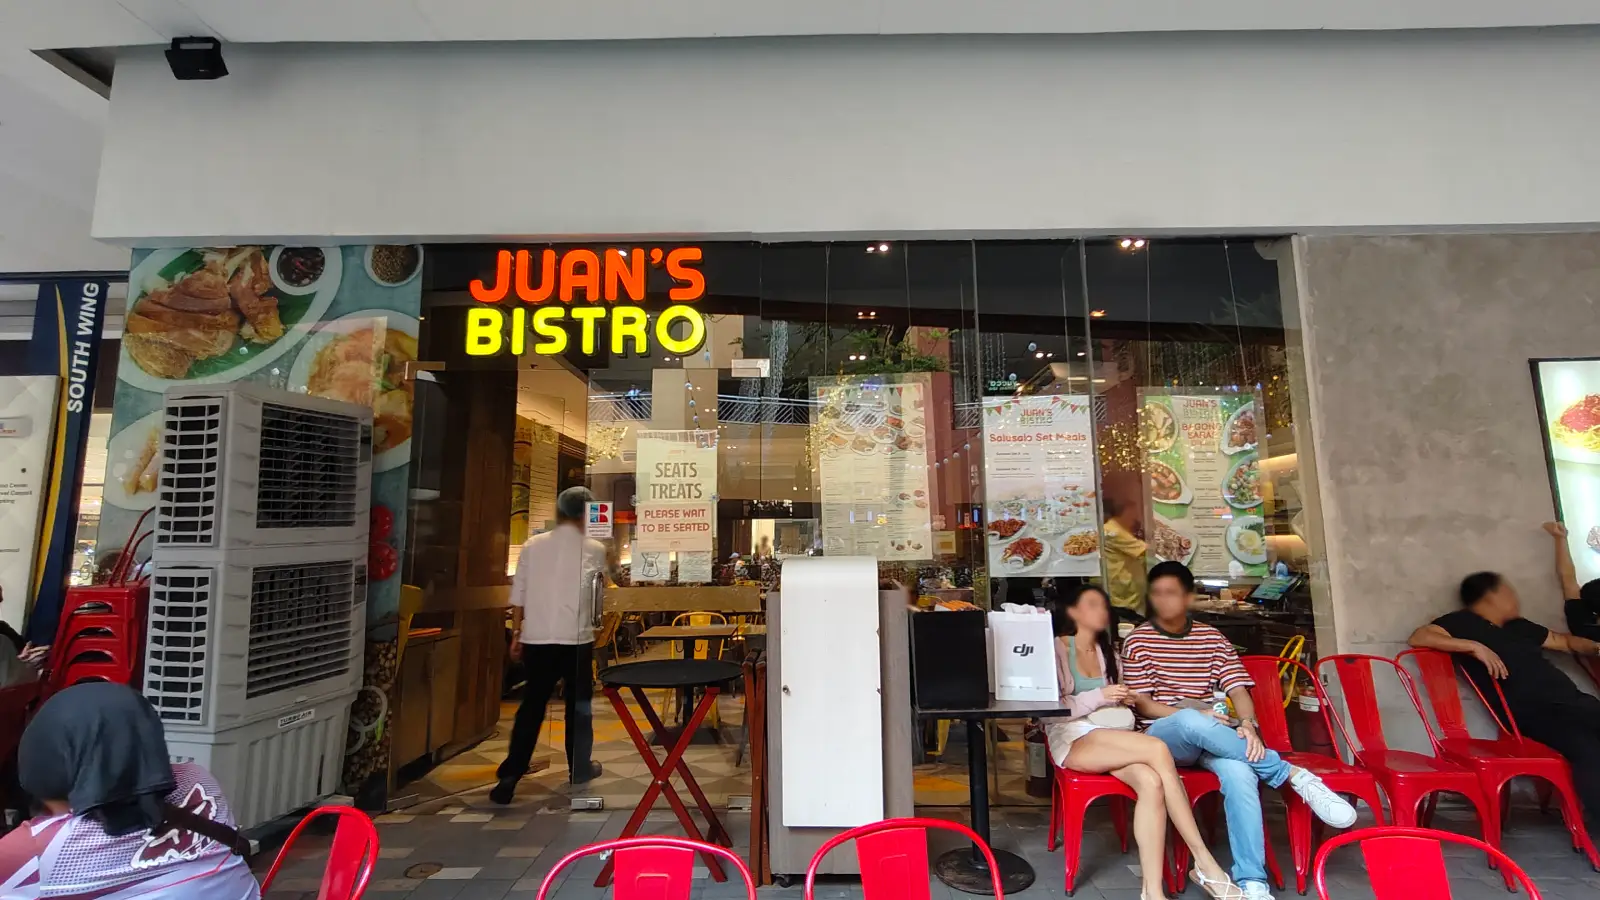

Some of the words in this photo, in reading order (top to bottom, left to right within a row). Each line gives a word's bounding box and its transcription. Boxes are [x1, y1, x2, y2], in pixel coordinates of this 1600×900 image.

[469, 247, 706, 302] JUAN'S
[76, 282, 100, 335] WING
[465, 305, 706, 356] BISTRO
[67, 341, 91, 413] SOUTH
[1020, 408, 1053, 416] JUAN'S
[989, 433, 1033, 443] Salusalo
[1035, 432, 1053, 442] Set
[655, 462, 698, 478] SEATS
[649, 483, 703, 499] TREATS
[644, 509, 680, 519] PLEASE
[682, 508, 706, 518] WAIT
[641, 523, 656, 533] TO
[657, 523, 671, 532] BE
[673, 522, 710, 532] SEATED
